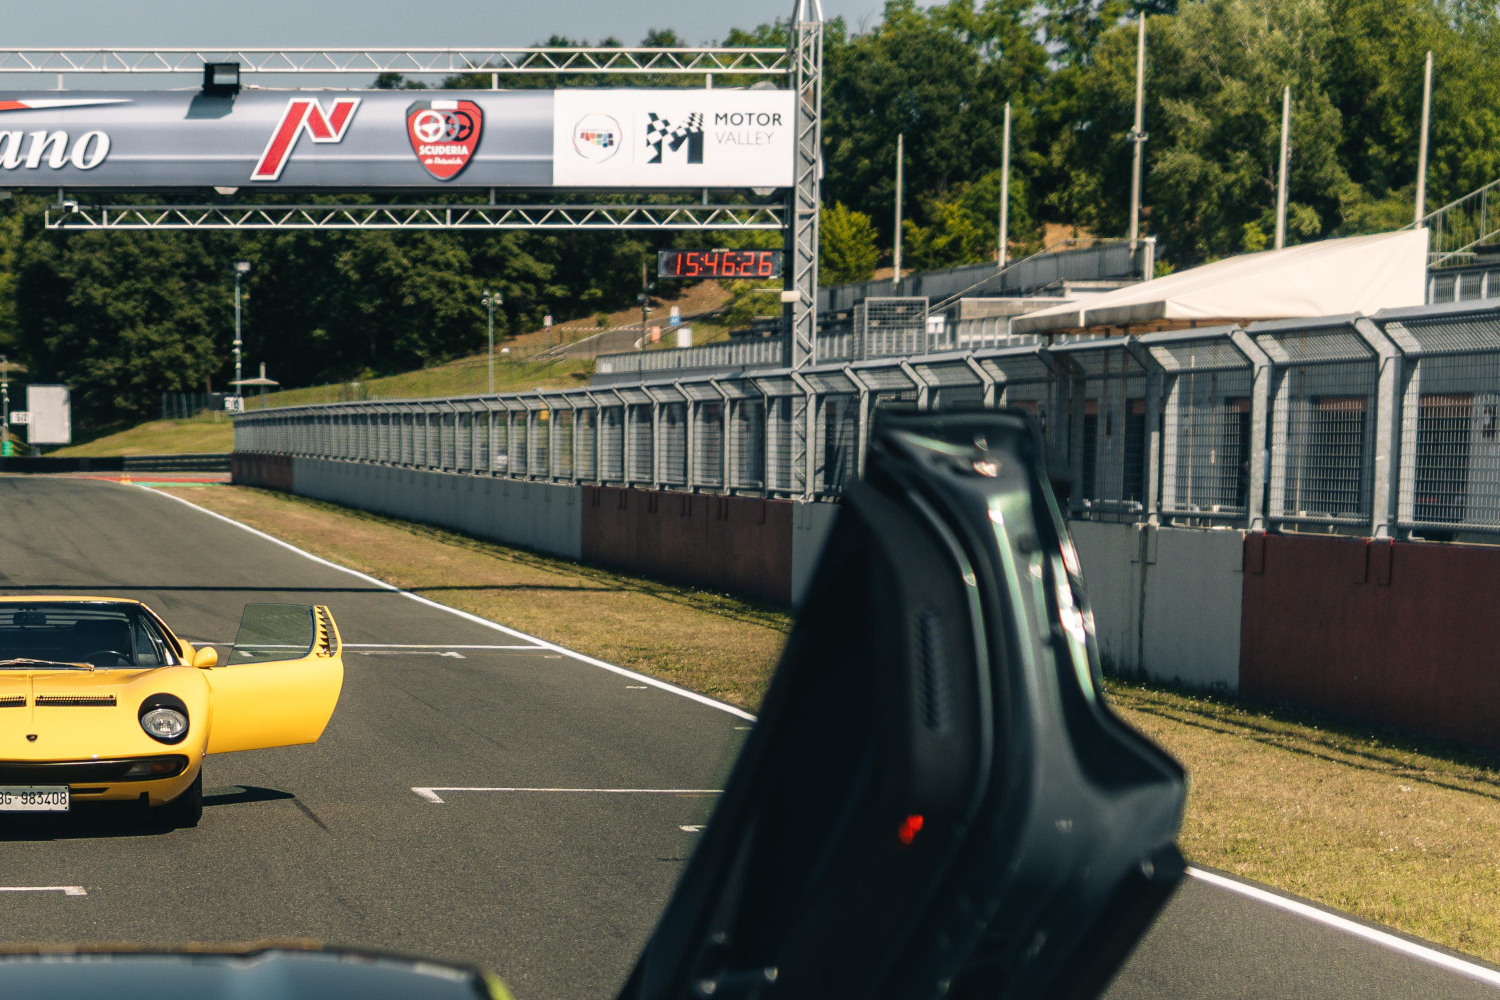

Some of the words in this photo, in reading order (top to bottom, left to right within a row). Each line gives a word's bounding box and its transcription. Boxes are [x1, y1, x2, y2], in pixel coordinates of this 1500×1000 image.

[714, 112, 782, 126] MOTOR
[716, 131, 775, 145] VALLEY
[419, 145, 469, 156] SCUDERIA
[676, 252, 773, 276] 15:46:26
